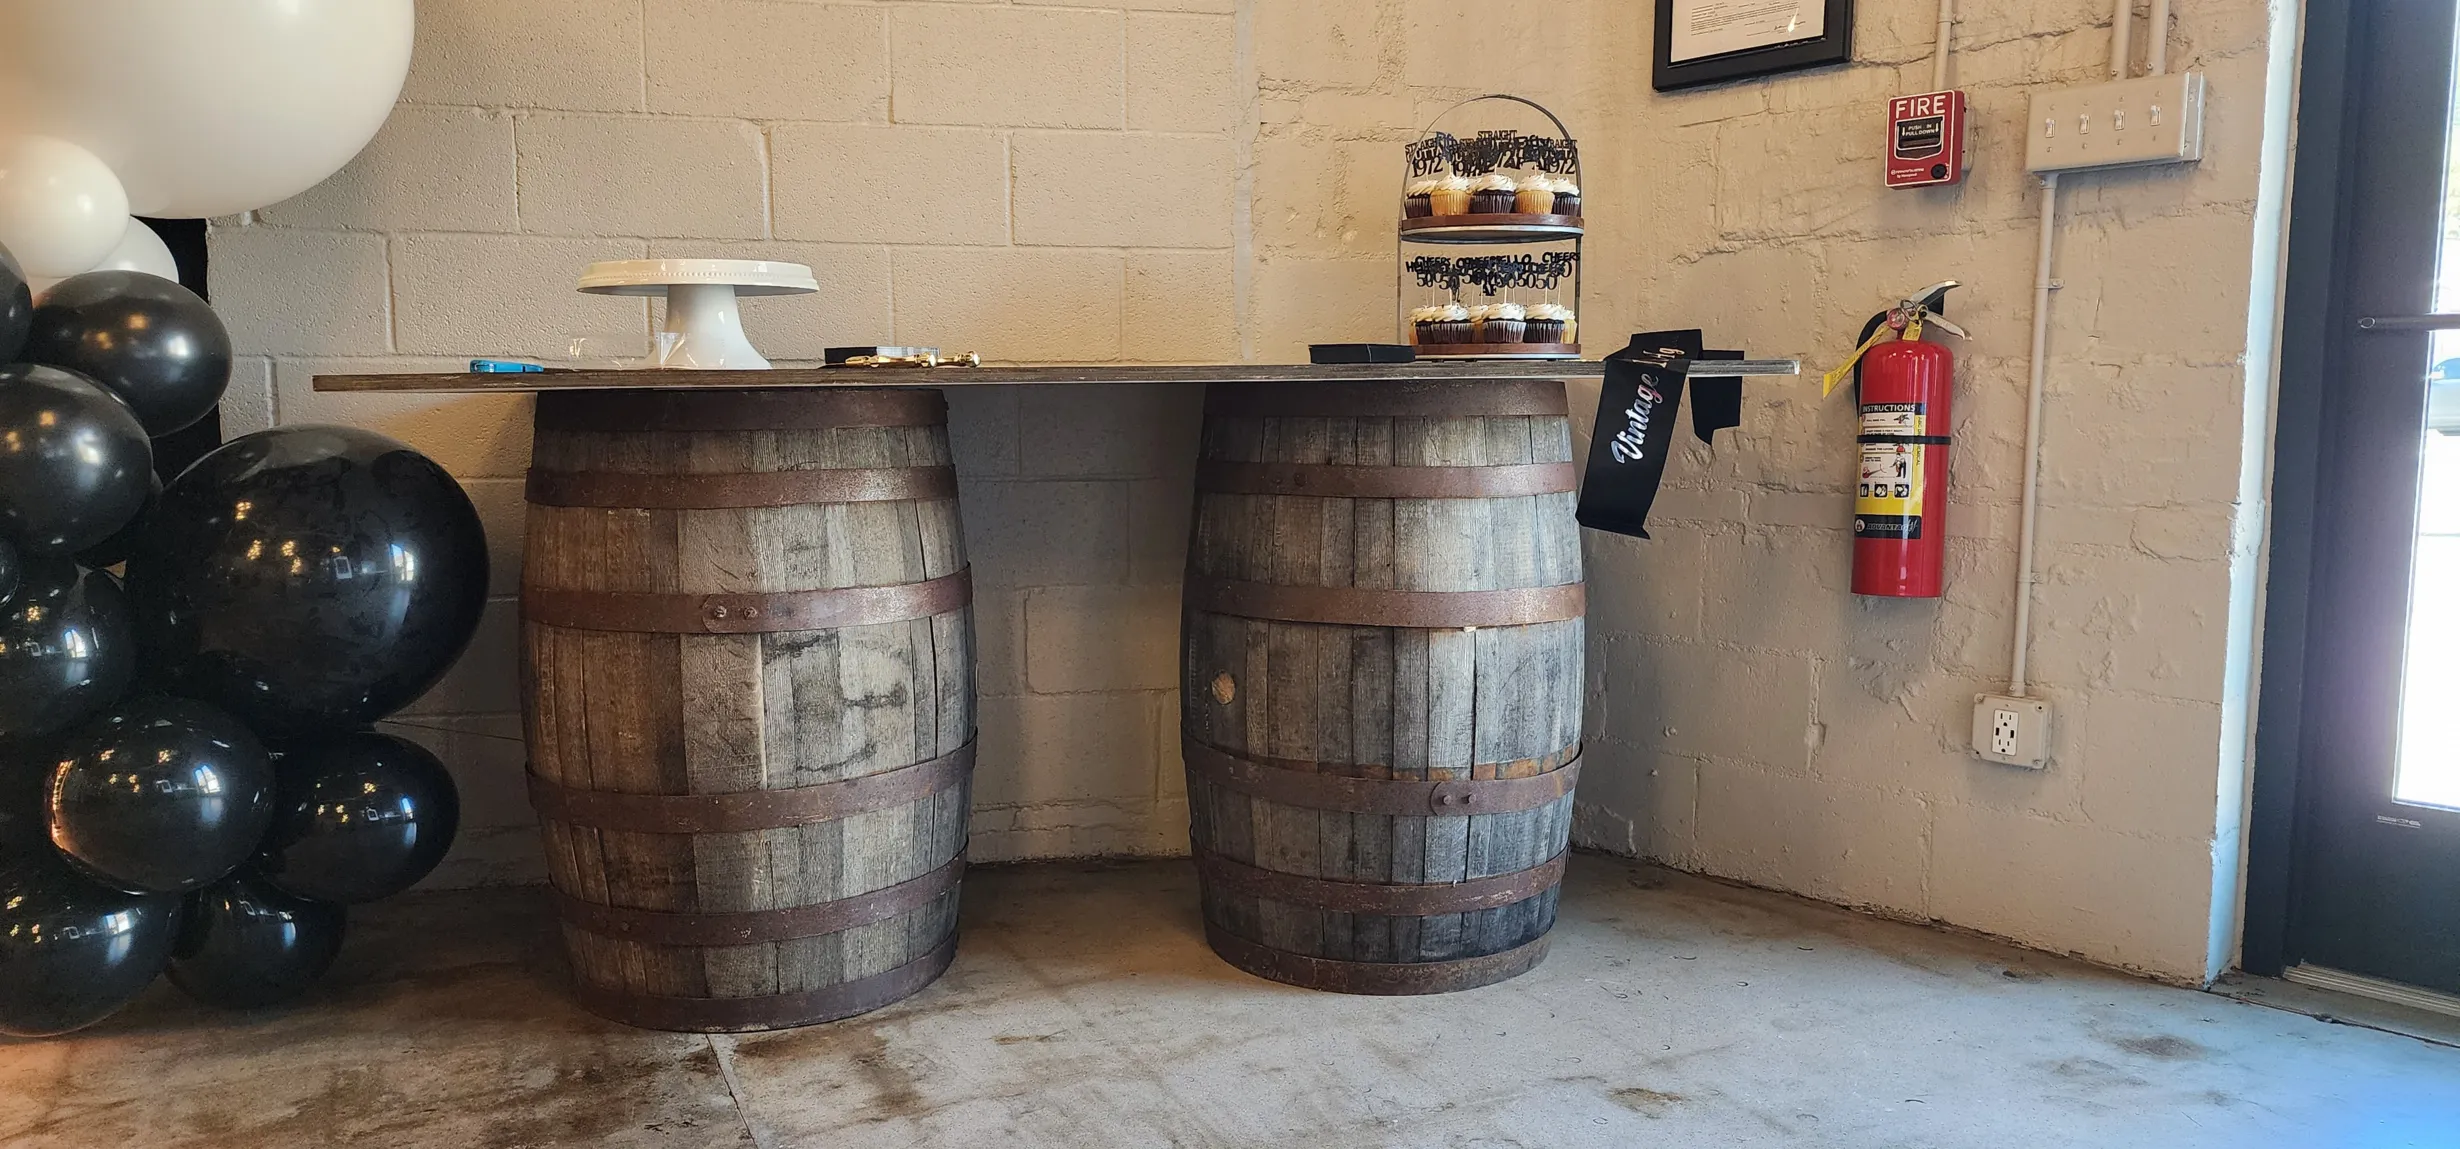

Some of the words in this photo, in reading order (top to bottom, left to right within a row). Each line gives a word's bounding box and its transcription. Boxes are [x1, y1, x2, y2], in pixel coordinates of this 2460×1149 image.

[1896, 95, 1946, 119] FIRE
[1477, 130, 1518, 141] STRAIGHT
[1412, 158, 1444, 178] 1972
[1611, 373, 1664, 464] Vintage
[1862, 404, 1916, 413] INSTRUCTIONS
